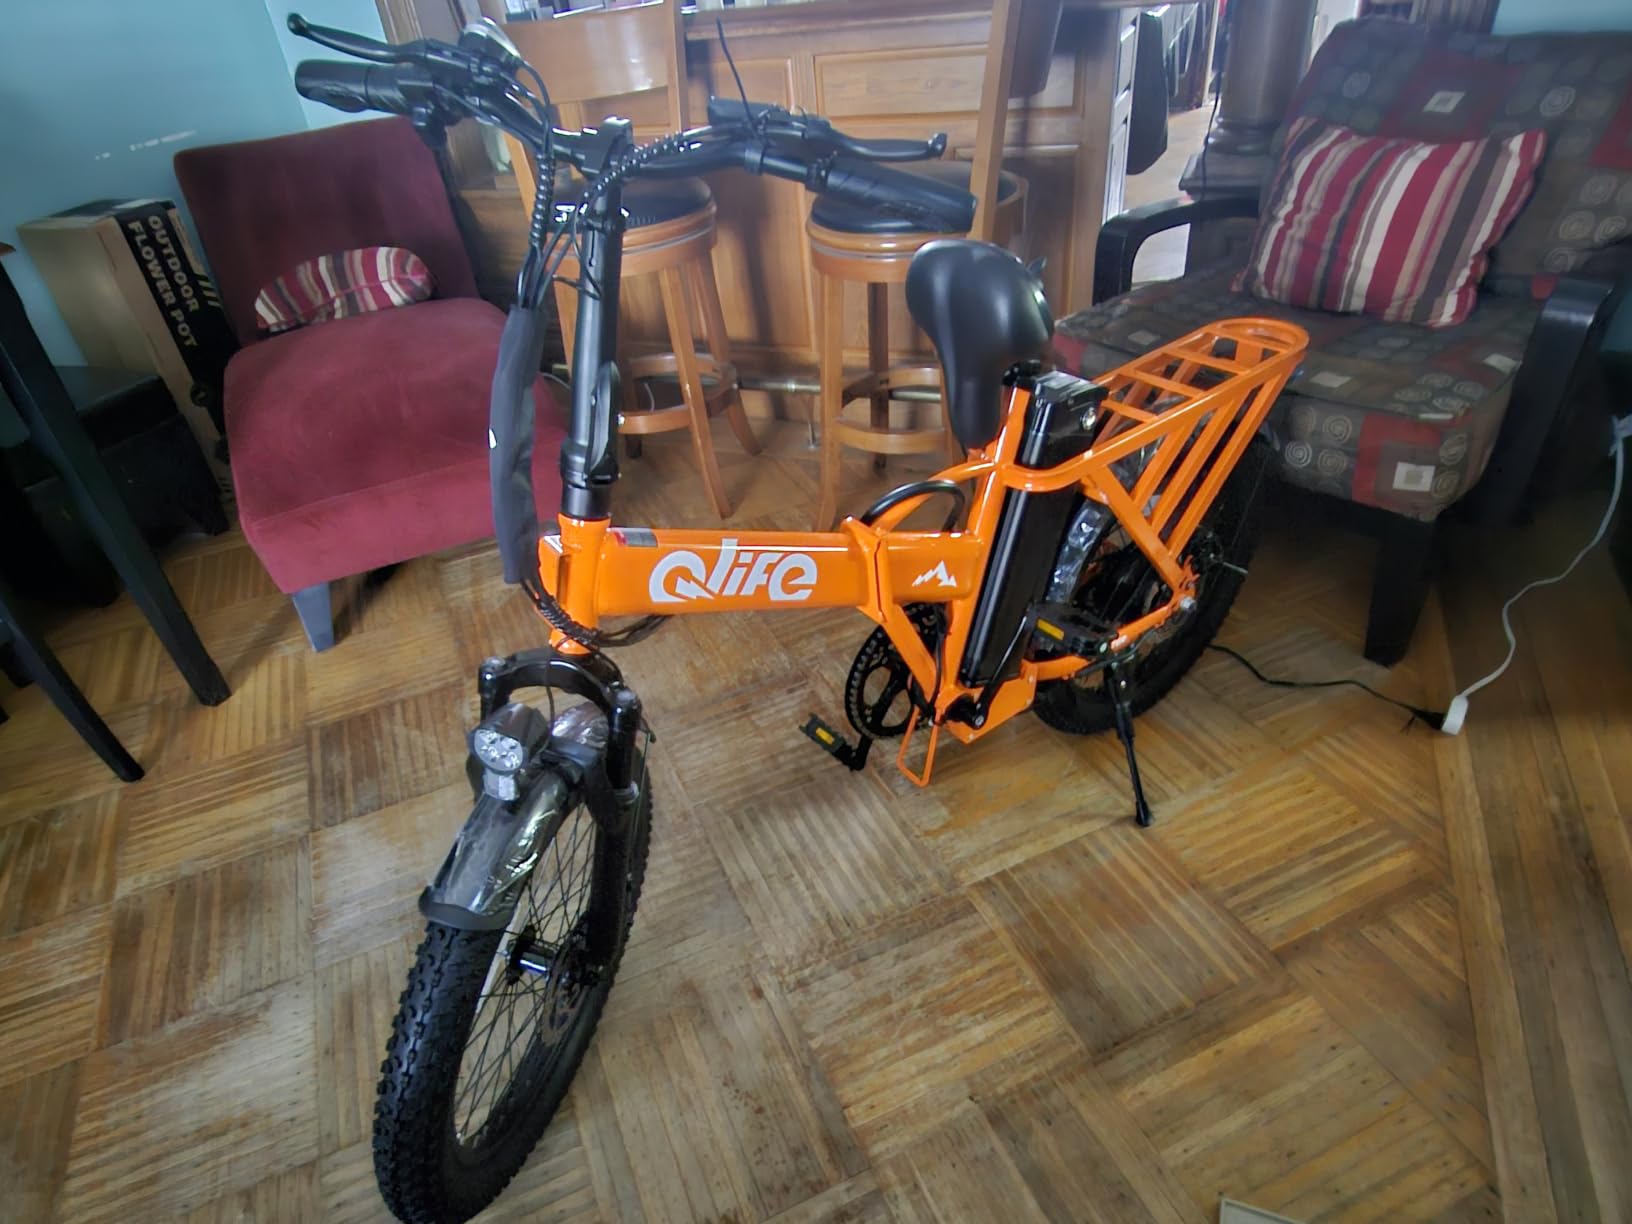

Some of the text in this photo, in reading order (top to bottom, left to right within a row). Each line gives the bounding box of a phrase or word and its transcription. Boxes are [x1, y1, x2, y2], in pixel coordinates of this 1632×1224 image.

[128, 220, 197, 347] FLOWER POT
[149, 215, 199, 312] OUTDOOR
